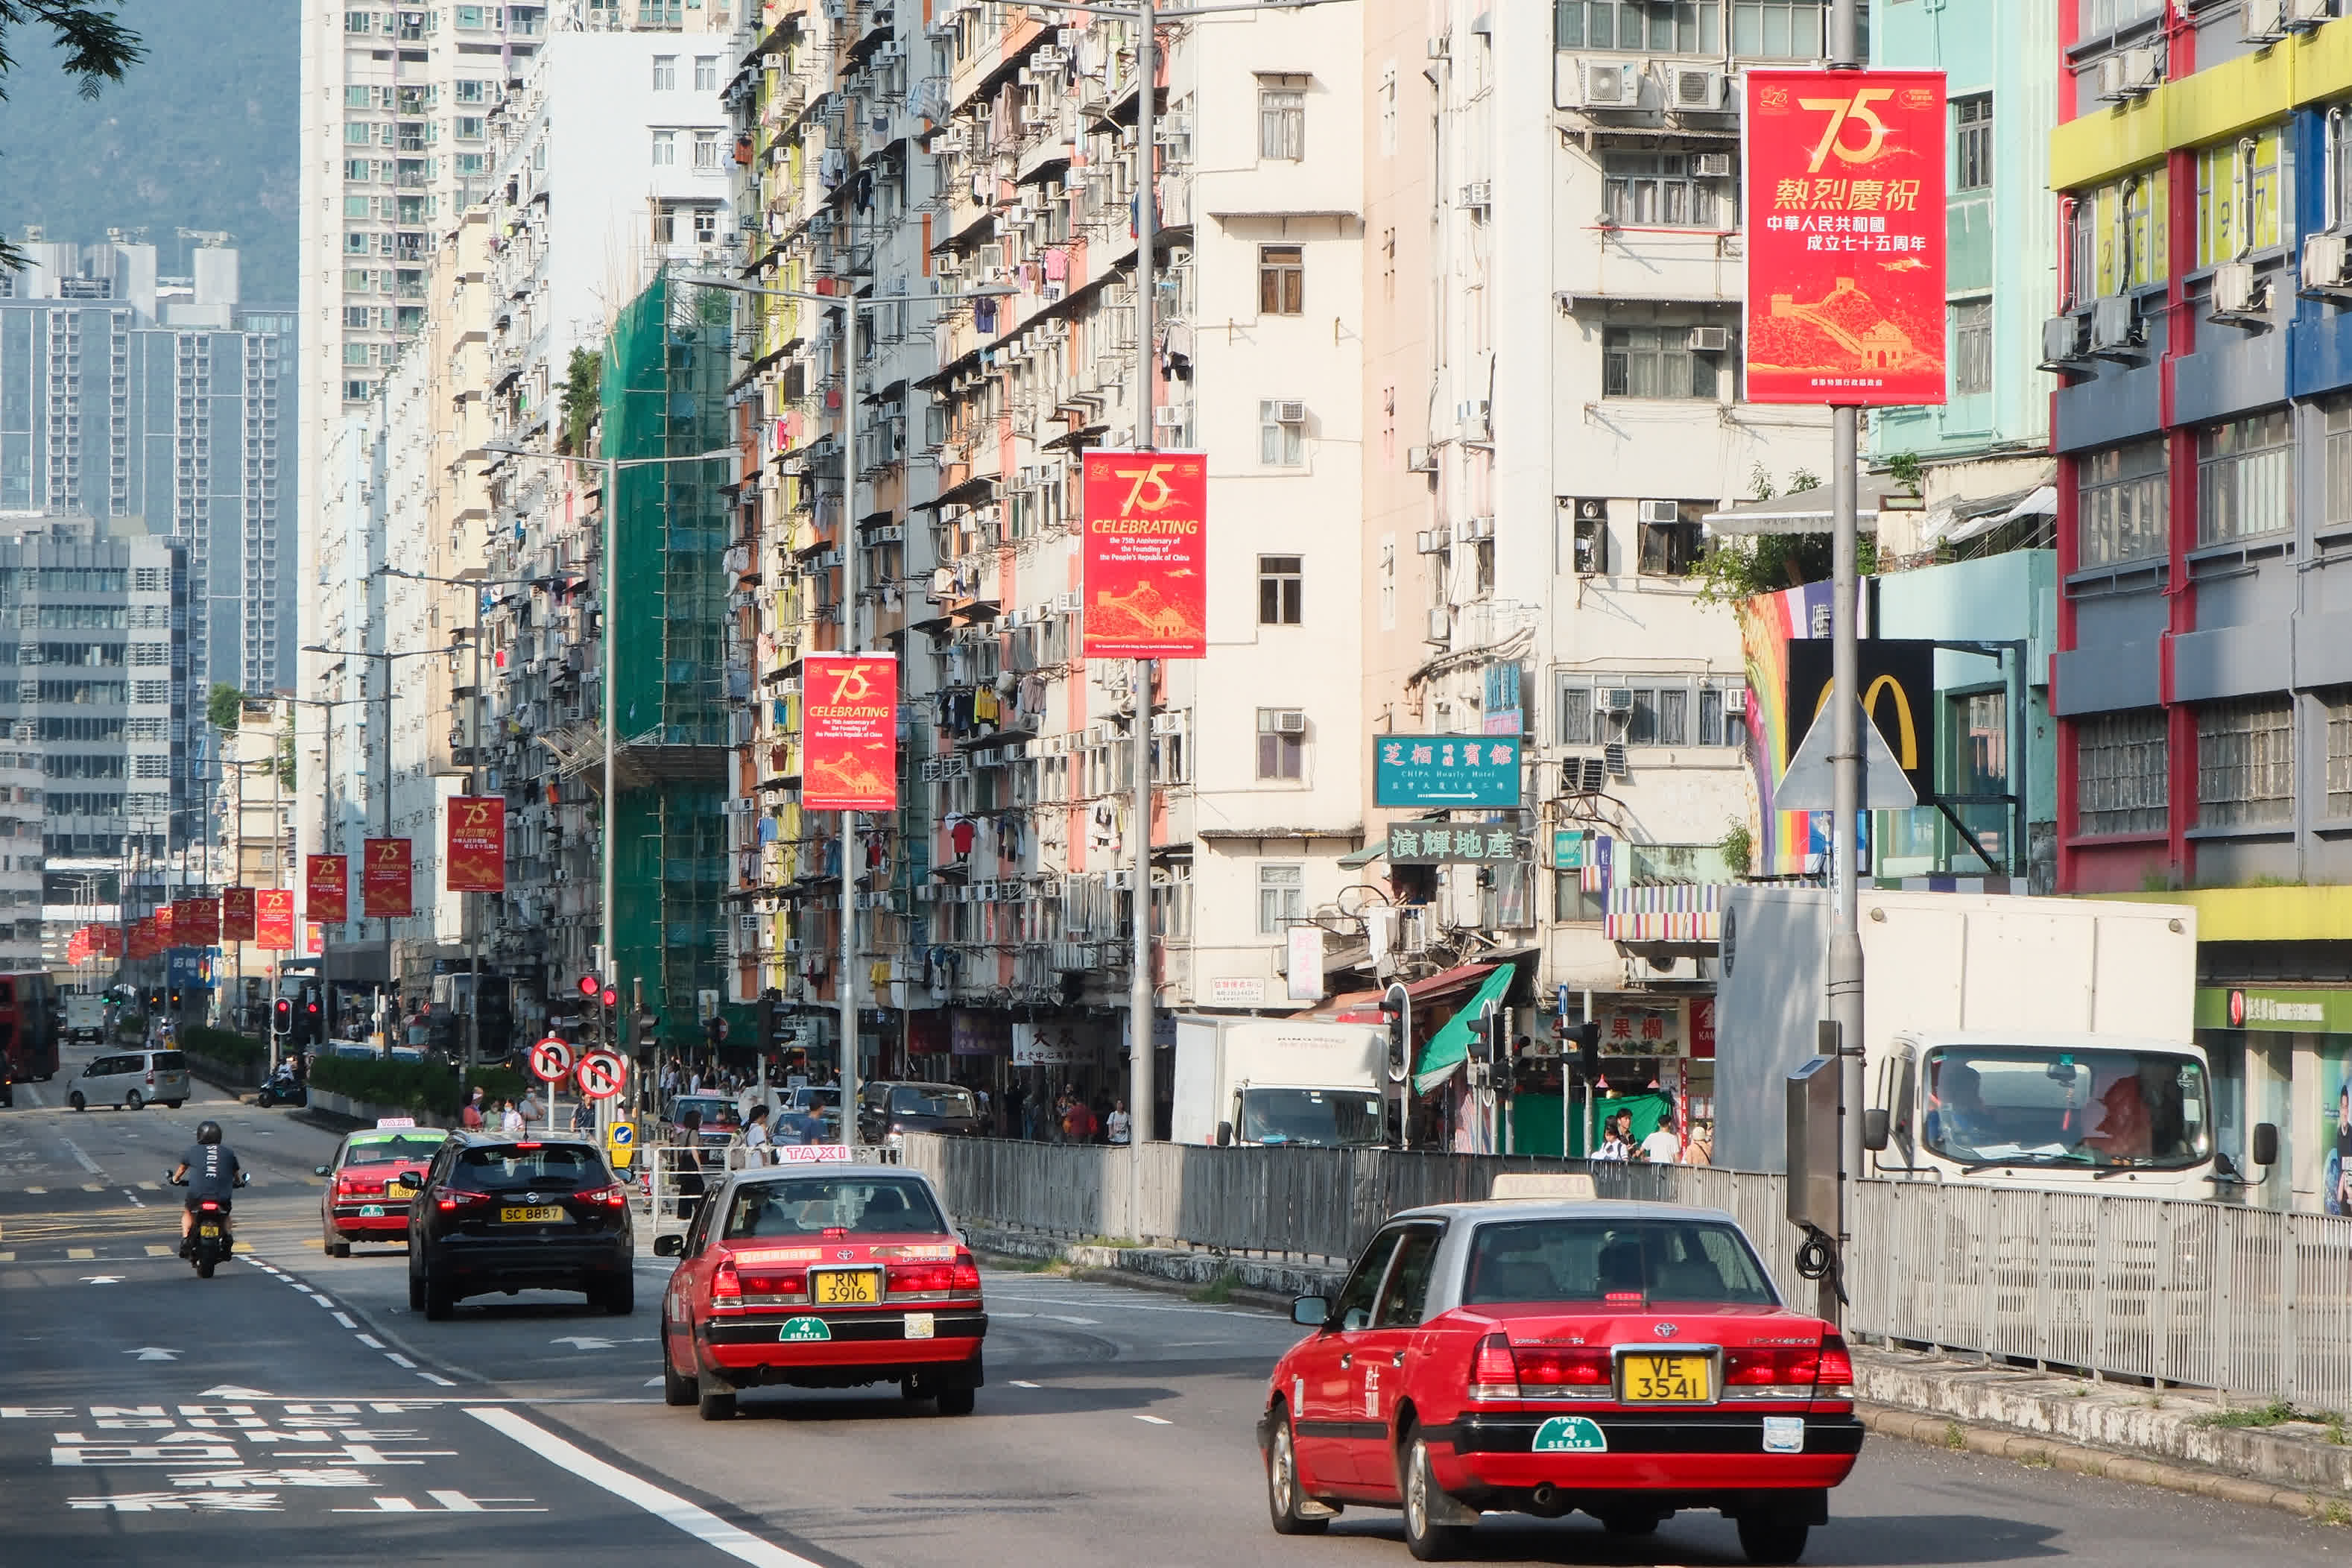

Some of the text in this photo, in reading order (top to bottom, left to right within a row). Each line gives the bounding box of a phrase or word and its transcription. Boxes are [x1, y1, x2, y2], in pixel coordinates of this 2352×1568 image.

[1798, 89, 1896, 173] 75
[1774, 178, 1921, 211] 熱烈慶祝
[1767, 215, 1885, 233] 中華人民共和國
[1806, 235, 1926, 252] 成立七十五周年
[1115, 464, 1175, 516] 75
[1092, 519, 1198, 534] CELEBRATING
[1137, 537, 1172, 546] Anniversary
[1133, 546, 1161, 554] Founding
[1111, 554, 1137, 562] People's
[1137, 554, 1163, 563] Republic
[826, 666, 872, 705] 75
[809, 706, 888, 718] CELEBRATING
[462, 802, 490, 827] 75
[1391, 829, 1514, 859] 演輝地產
[376, 842, 399, 862] 75
[317, 859, 338, 876] 75
[266, 893, 285, 908] 75
[1550, 1016, 1663, 1040] 生果欄
[787, 1146, 846, 1160] TAXI
[205, 1145, 218, 1178] SVOLME
[506, 1208, 558, 1220] SC 8887
[835, 1273, 859, 1287] RN
[829, 1287, 867, 1301] 3916
[800, 1323, 810, 1333] 4
[1650, 1358, 1683, 1378] VE
[1639, 1378, 1697, 1399] 3541
[0, 1403, 444, 1417] END OF
[95, 1417, 362, 1429] BUS
[54, 1429, 430, 1444] LANE
[1562, 1426, 1577, 1439] 4
[1548, 1440, 1592, 1449] SEATS
[51, 1444, 459, 1466] 巴士
